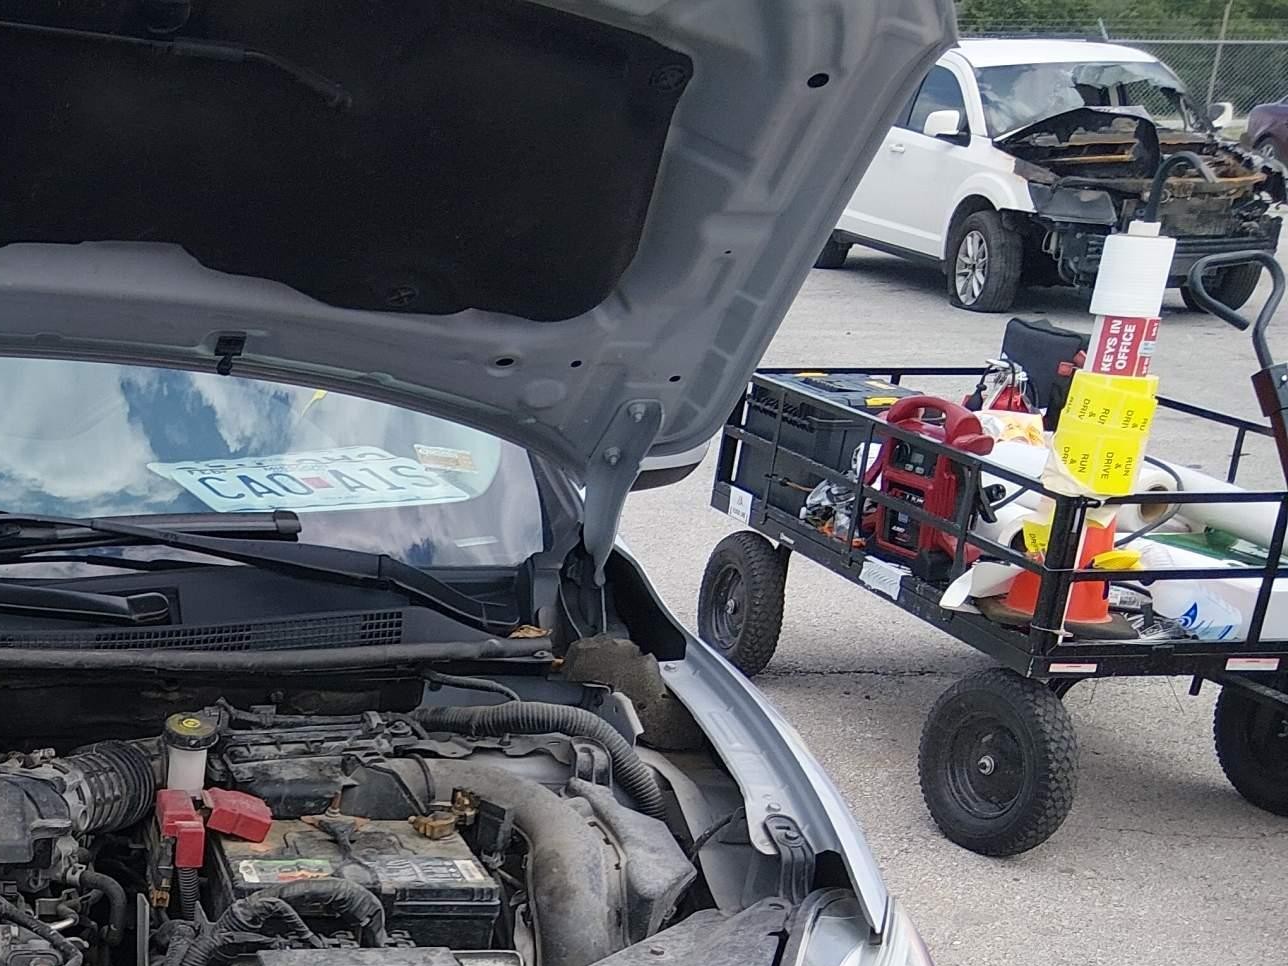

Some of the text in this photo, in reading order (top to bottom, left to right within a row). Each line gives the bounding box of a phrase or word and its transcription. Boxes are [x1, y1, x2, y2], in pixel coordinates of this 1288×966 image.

[1101, 319, 1122, 371] KEYS IN
[1115, 324, 1136, 370] OFFICE
[1078, 453, 1090, 474] RUN
[1100, 452, 1114, 480] DRIVE
[1123, 456, 1133, 477] RUN
